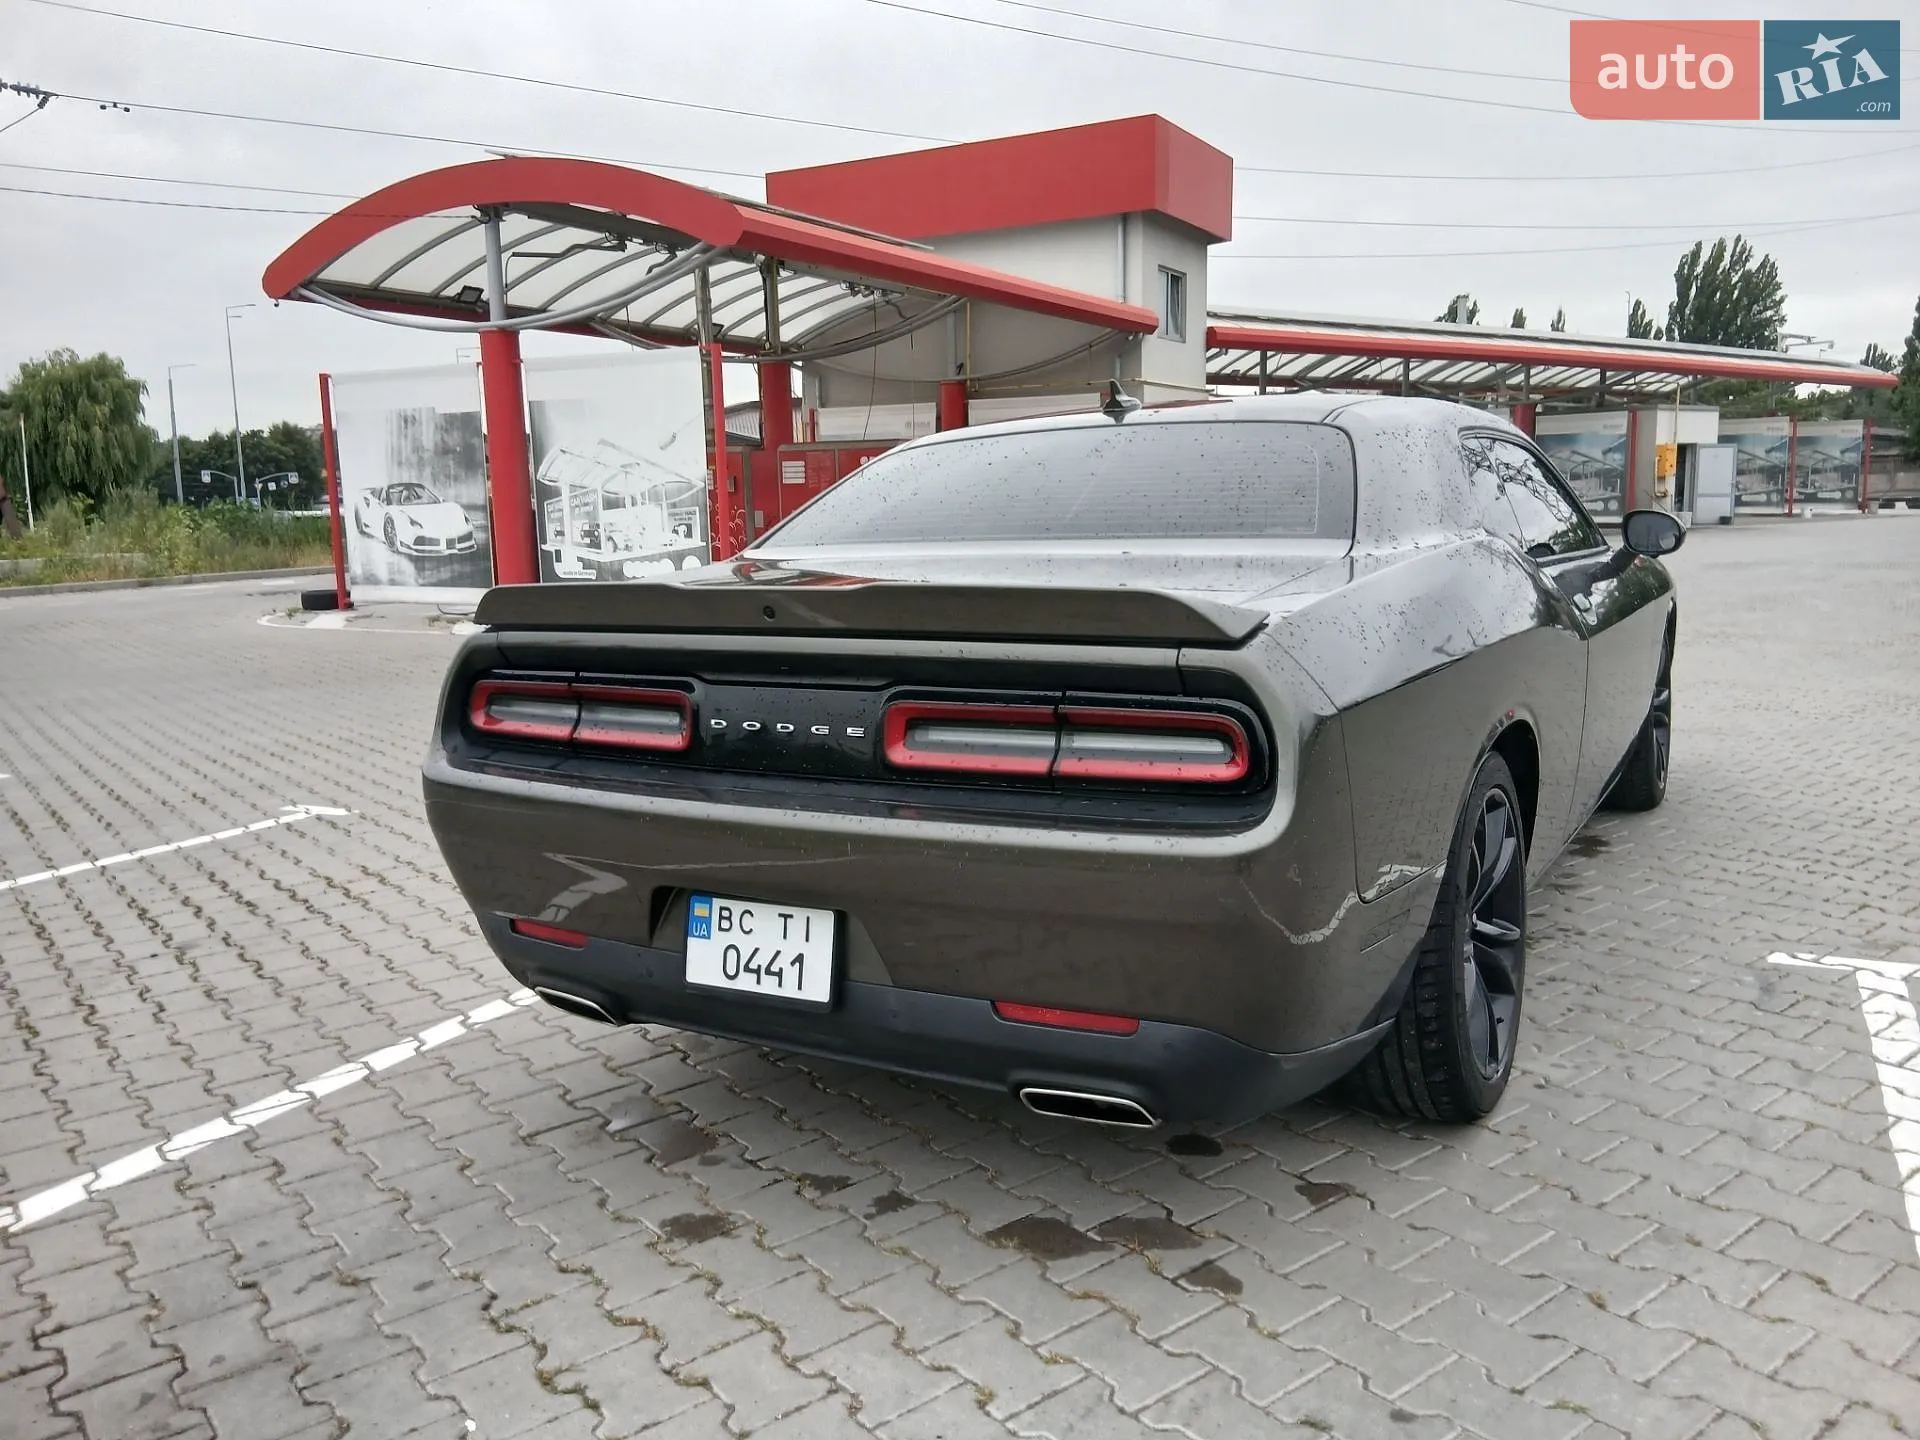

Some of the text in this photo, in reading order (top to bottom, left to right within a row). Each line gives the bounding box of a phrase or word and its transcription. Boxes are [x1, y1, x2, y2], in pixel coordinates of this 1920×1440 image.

[710, 719, 865, 737] DODGE
[692, 921, 708, 937] UA
[717, 905, 810, 943] BC TI
[722, 943, 805, 991] 0441
